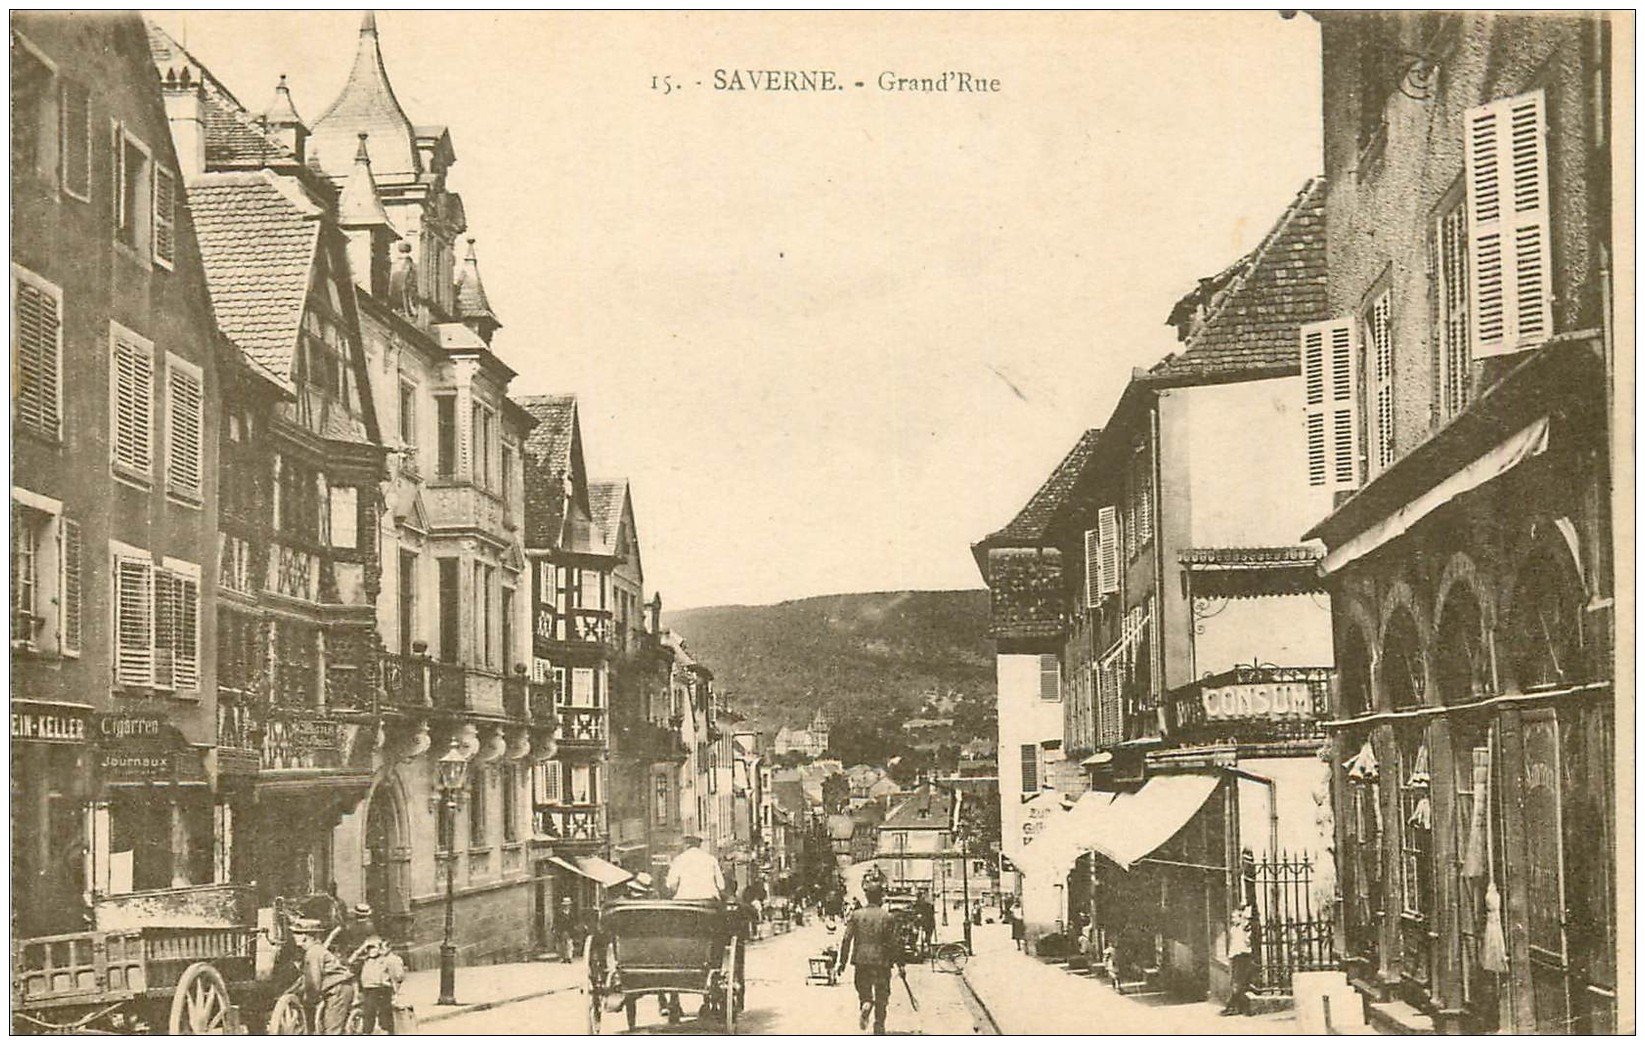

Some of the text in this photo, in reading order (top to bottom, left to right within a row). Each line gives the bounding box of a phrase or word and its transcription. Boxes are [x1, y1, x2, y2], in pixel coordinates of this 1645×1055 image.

[1202, 683, 1314, 719] CONSUM
[101, 718, 159, 738] Cigarren
[101, 757, 168, 767] Journaux
